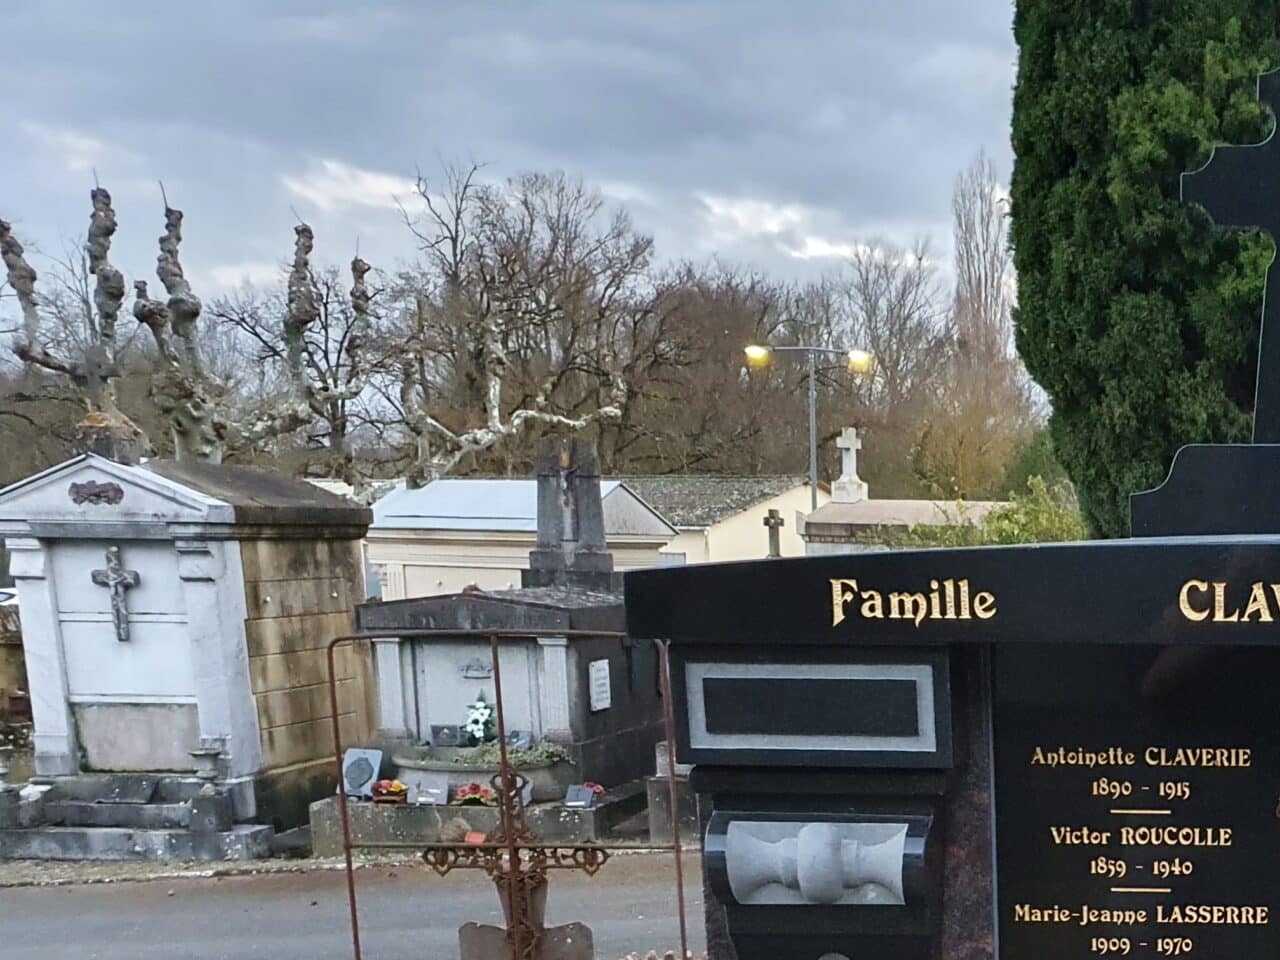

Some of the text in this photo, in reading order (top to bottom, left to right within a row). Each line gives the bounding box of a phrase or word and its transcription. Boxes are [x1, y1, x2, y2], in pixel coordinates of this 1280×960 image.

[830, 579, 996, 627] Famille
[1031, 747, 1251, 768] Antoinette CLAVERIE
[1092, 778, 1132, 799] 1890
[1159, 781, 1190, 800] 1915
[1050, 827, 1232, 846] Victor ROUCOLLE
[1090, 857, 1126, 878] 1859
[1152, 858, 1193, 878] 1940
[1014, 904, 1269, 926] Marie-Jeanne LASSERRE
[1091, 937, 1131, 955] 1909
[1157, 938, 1193, 955] 1970
